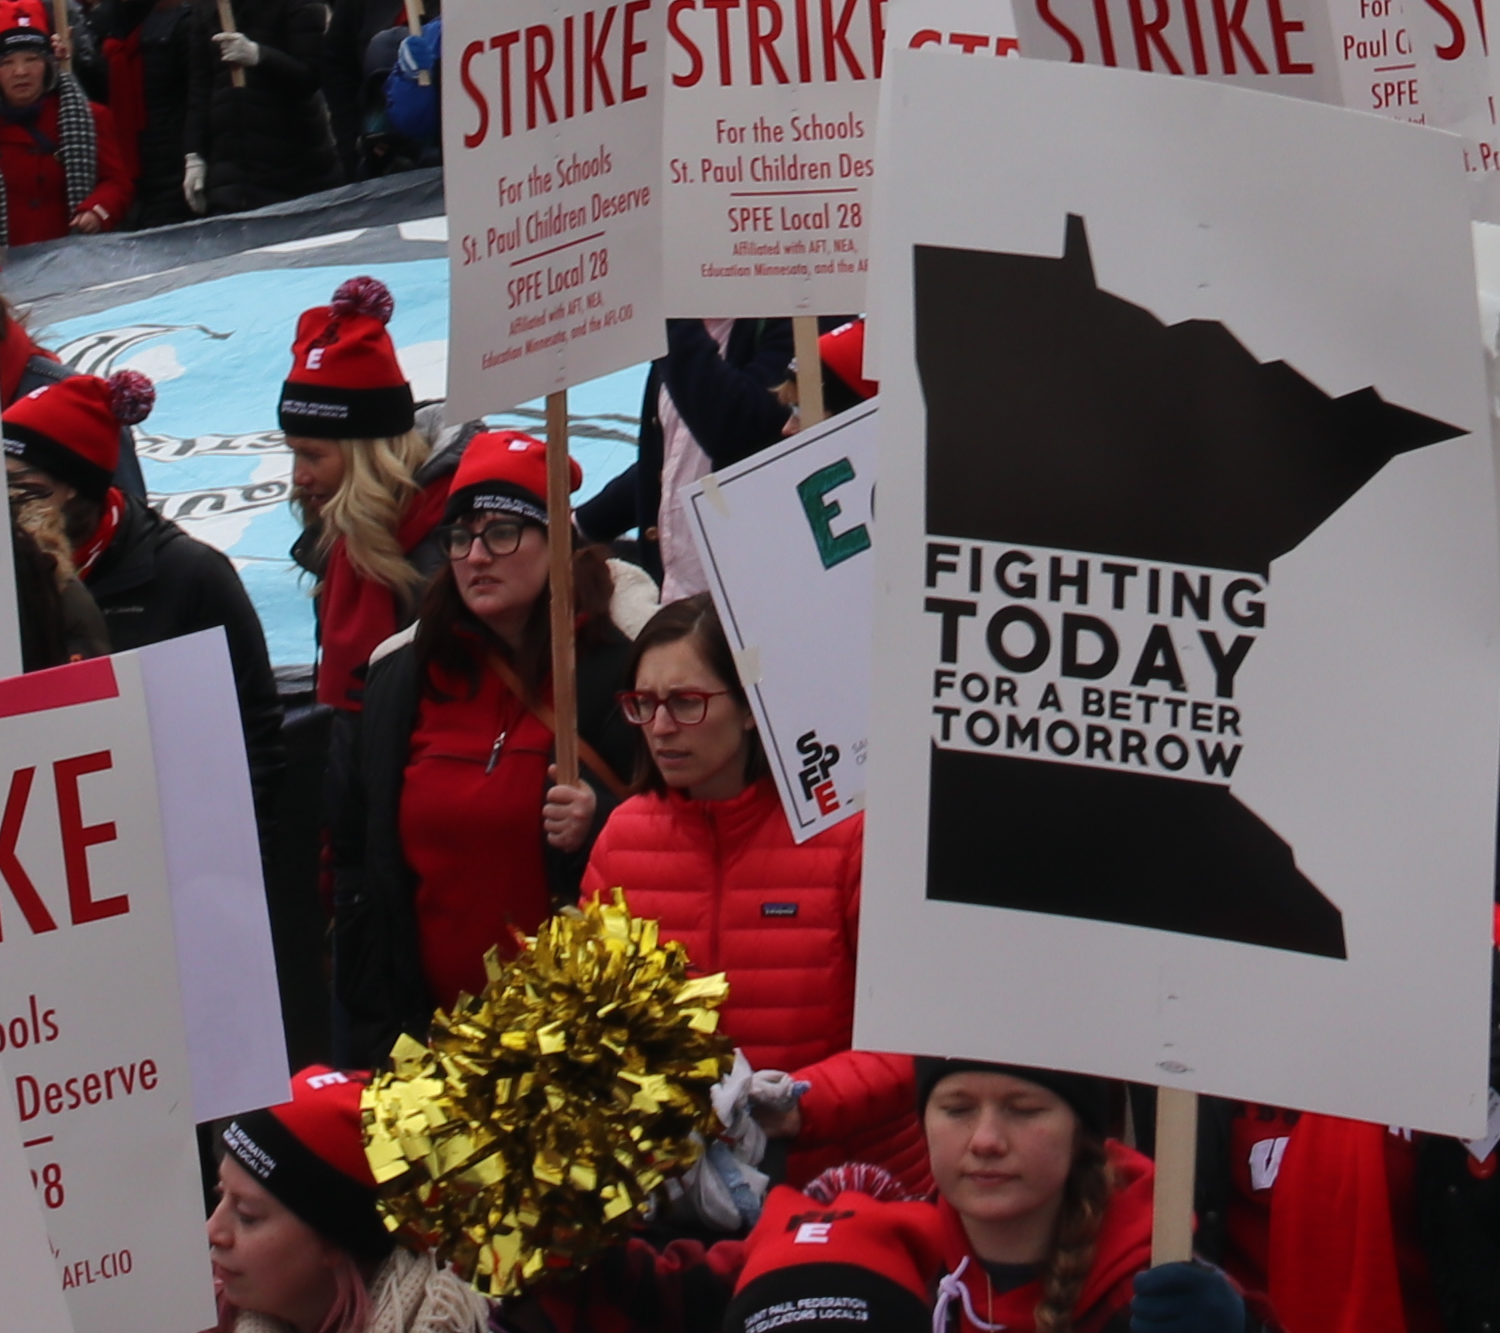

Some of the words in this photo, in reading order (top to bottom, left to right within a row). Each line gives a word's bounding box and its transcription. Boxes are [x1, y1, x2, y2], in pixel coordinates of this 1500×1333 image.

[925, 543, 1265, 641] FIGHTING
[925, 597, 1255, 707] TODAY
[933, 702, 1242, 777] TOMORROW
[934, 670, 1017, 707] FOR
[1038, 683, 1062, 712] A
[1082, 679, 1240, 744] BETTER
